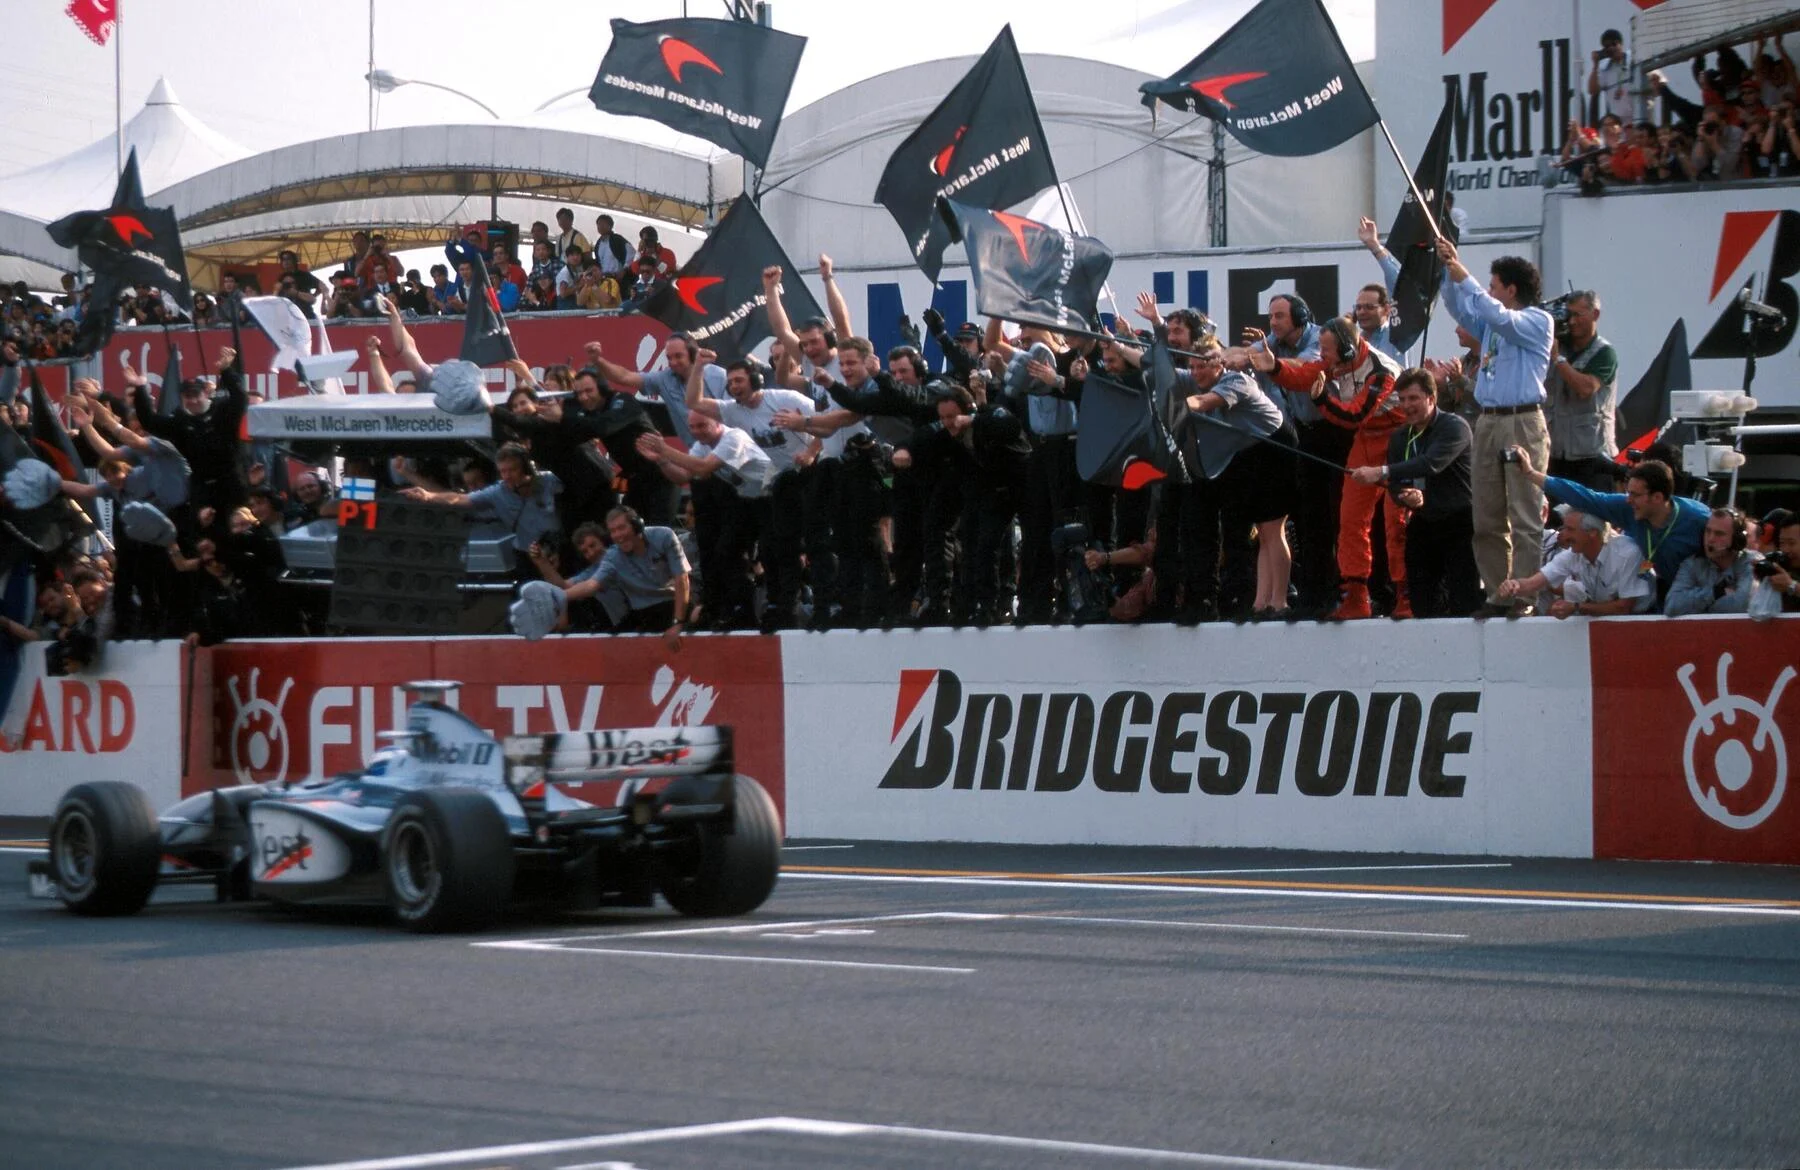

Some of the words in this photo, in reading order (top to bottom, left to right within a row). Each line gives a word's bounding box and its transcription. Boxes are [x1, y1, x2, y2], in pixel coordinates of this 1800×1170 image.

[1442, 38, 1600, 163] Marlb
[284, 415, 317, 432] West
[321, 415, 381, 432] McLaren
[385, 415, 454, 433] Mercedes
[337, 502, 378, 530] P1
[0, 677, 136, 754] ARD
[877, 668, 1481, 798] BRIDGESTONE
[252, 822, 310, 870] est
